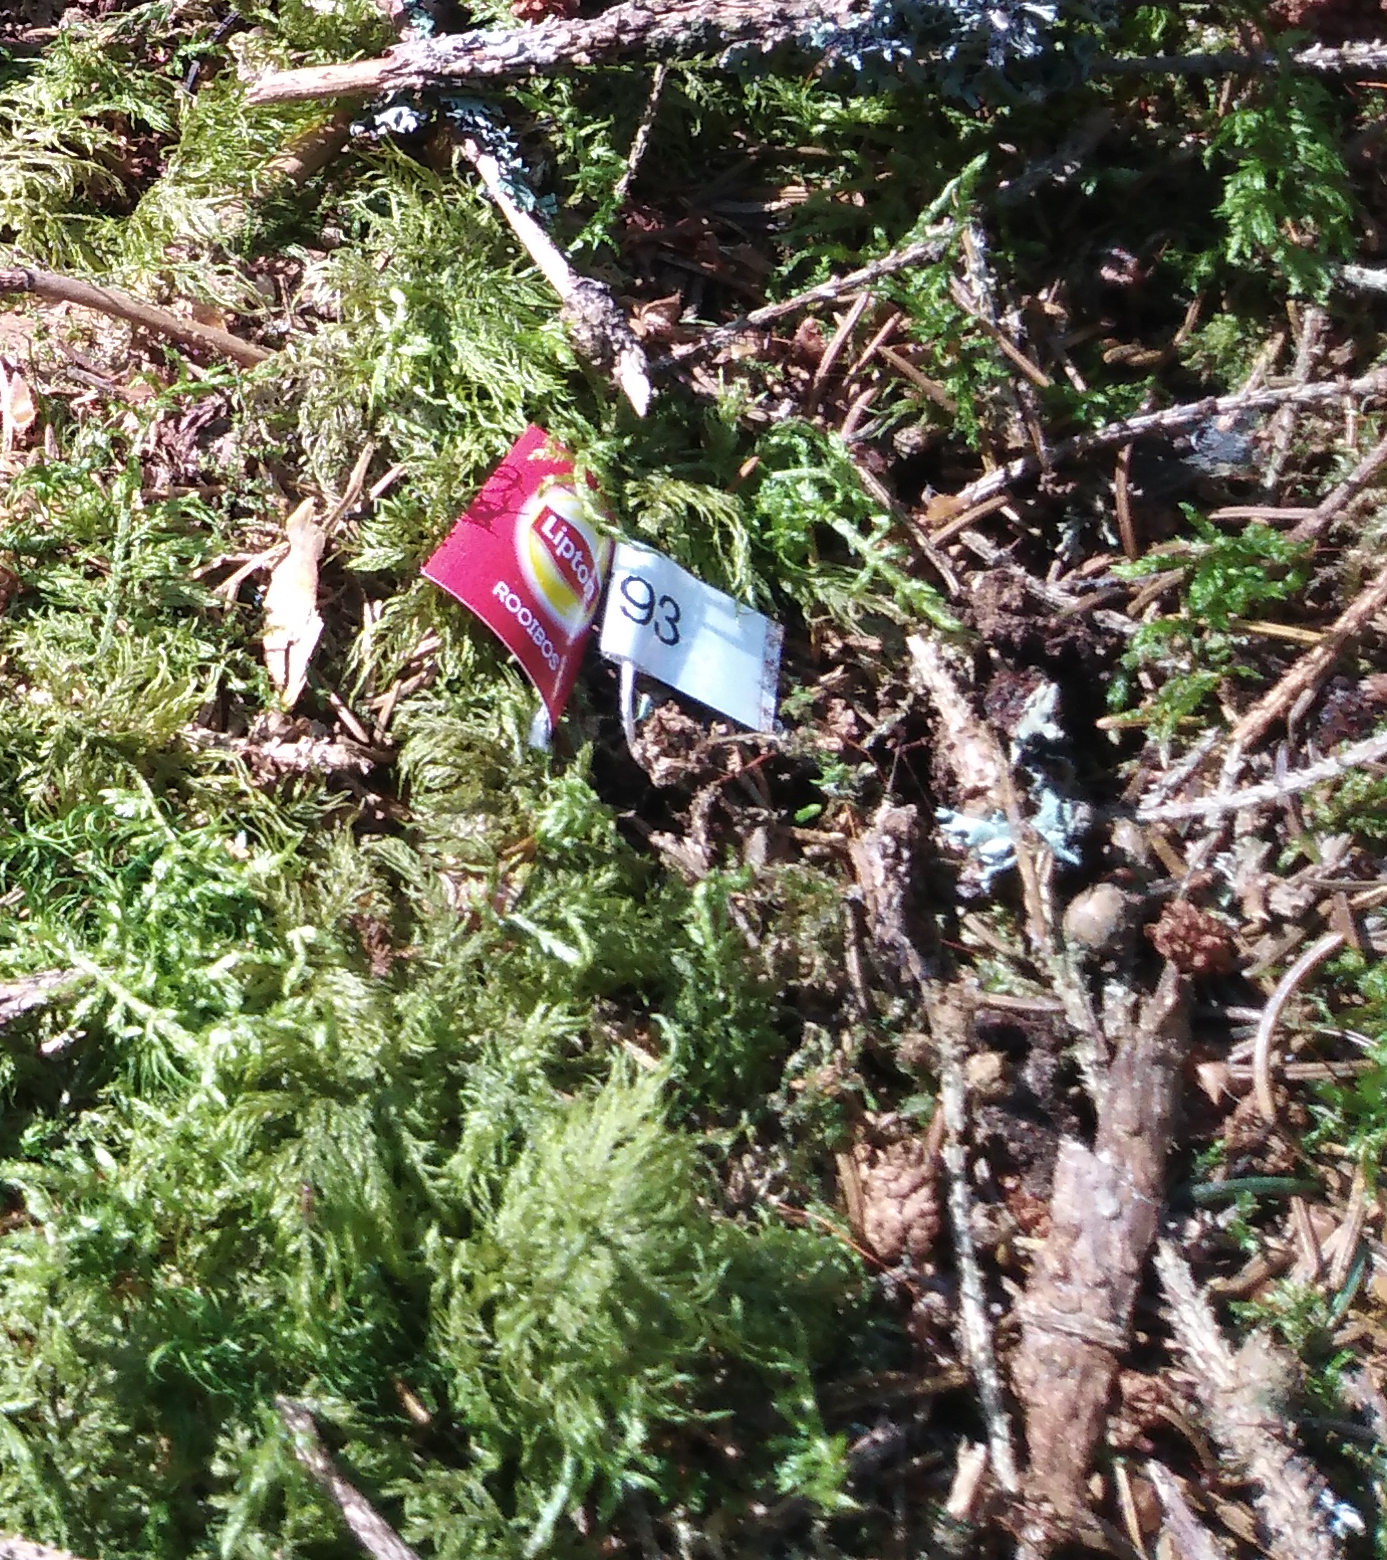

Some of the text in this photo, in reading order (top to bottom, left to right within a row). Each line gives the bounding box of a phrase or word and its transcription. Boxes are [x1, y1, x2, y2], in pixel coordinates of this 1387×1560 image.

[542, 514, 595, 602] Lipton
[492, 580, 560, 671] ROOIBOS
[619, 574, 681, 647] 93
